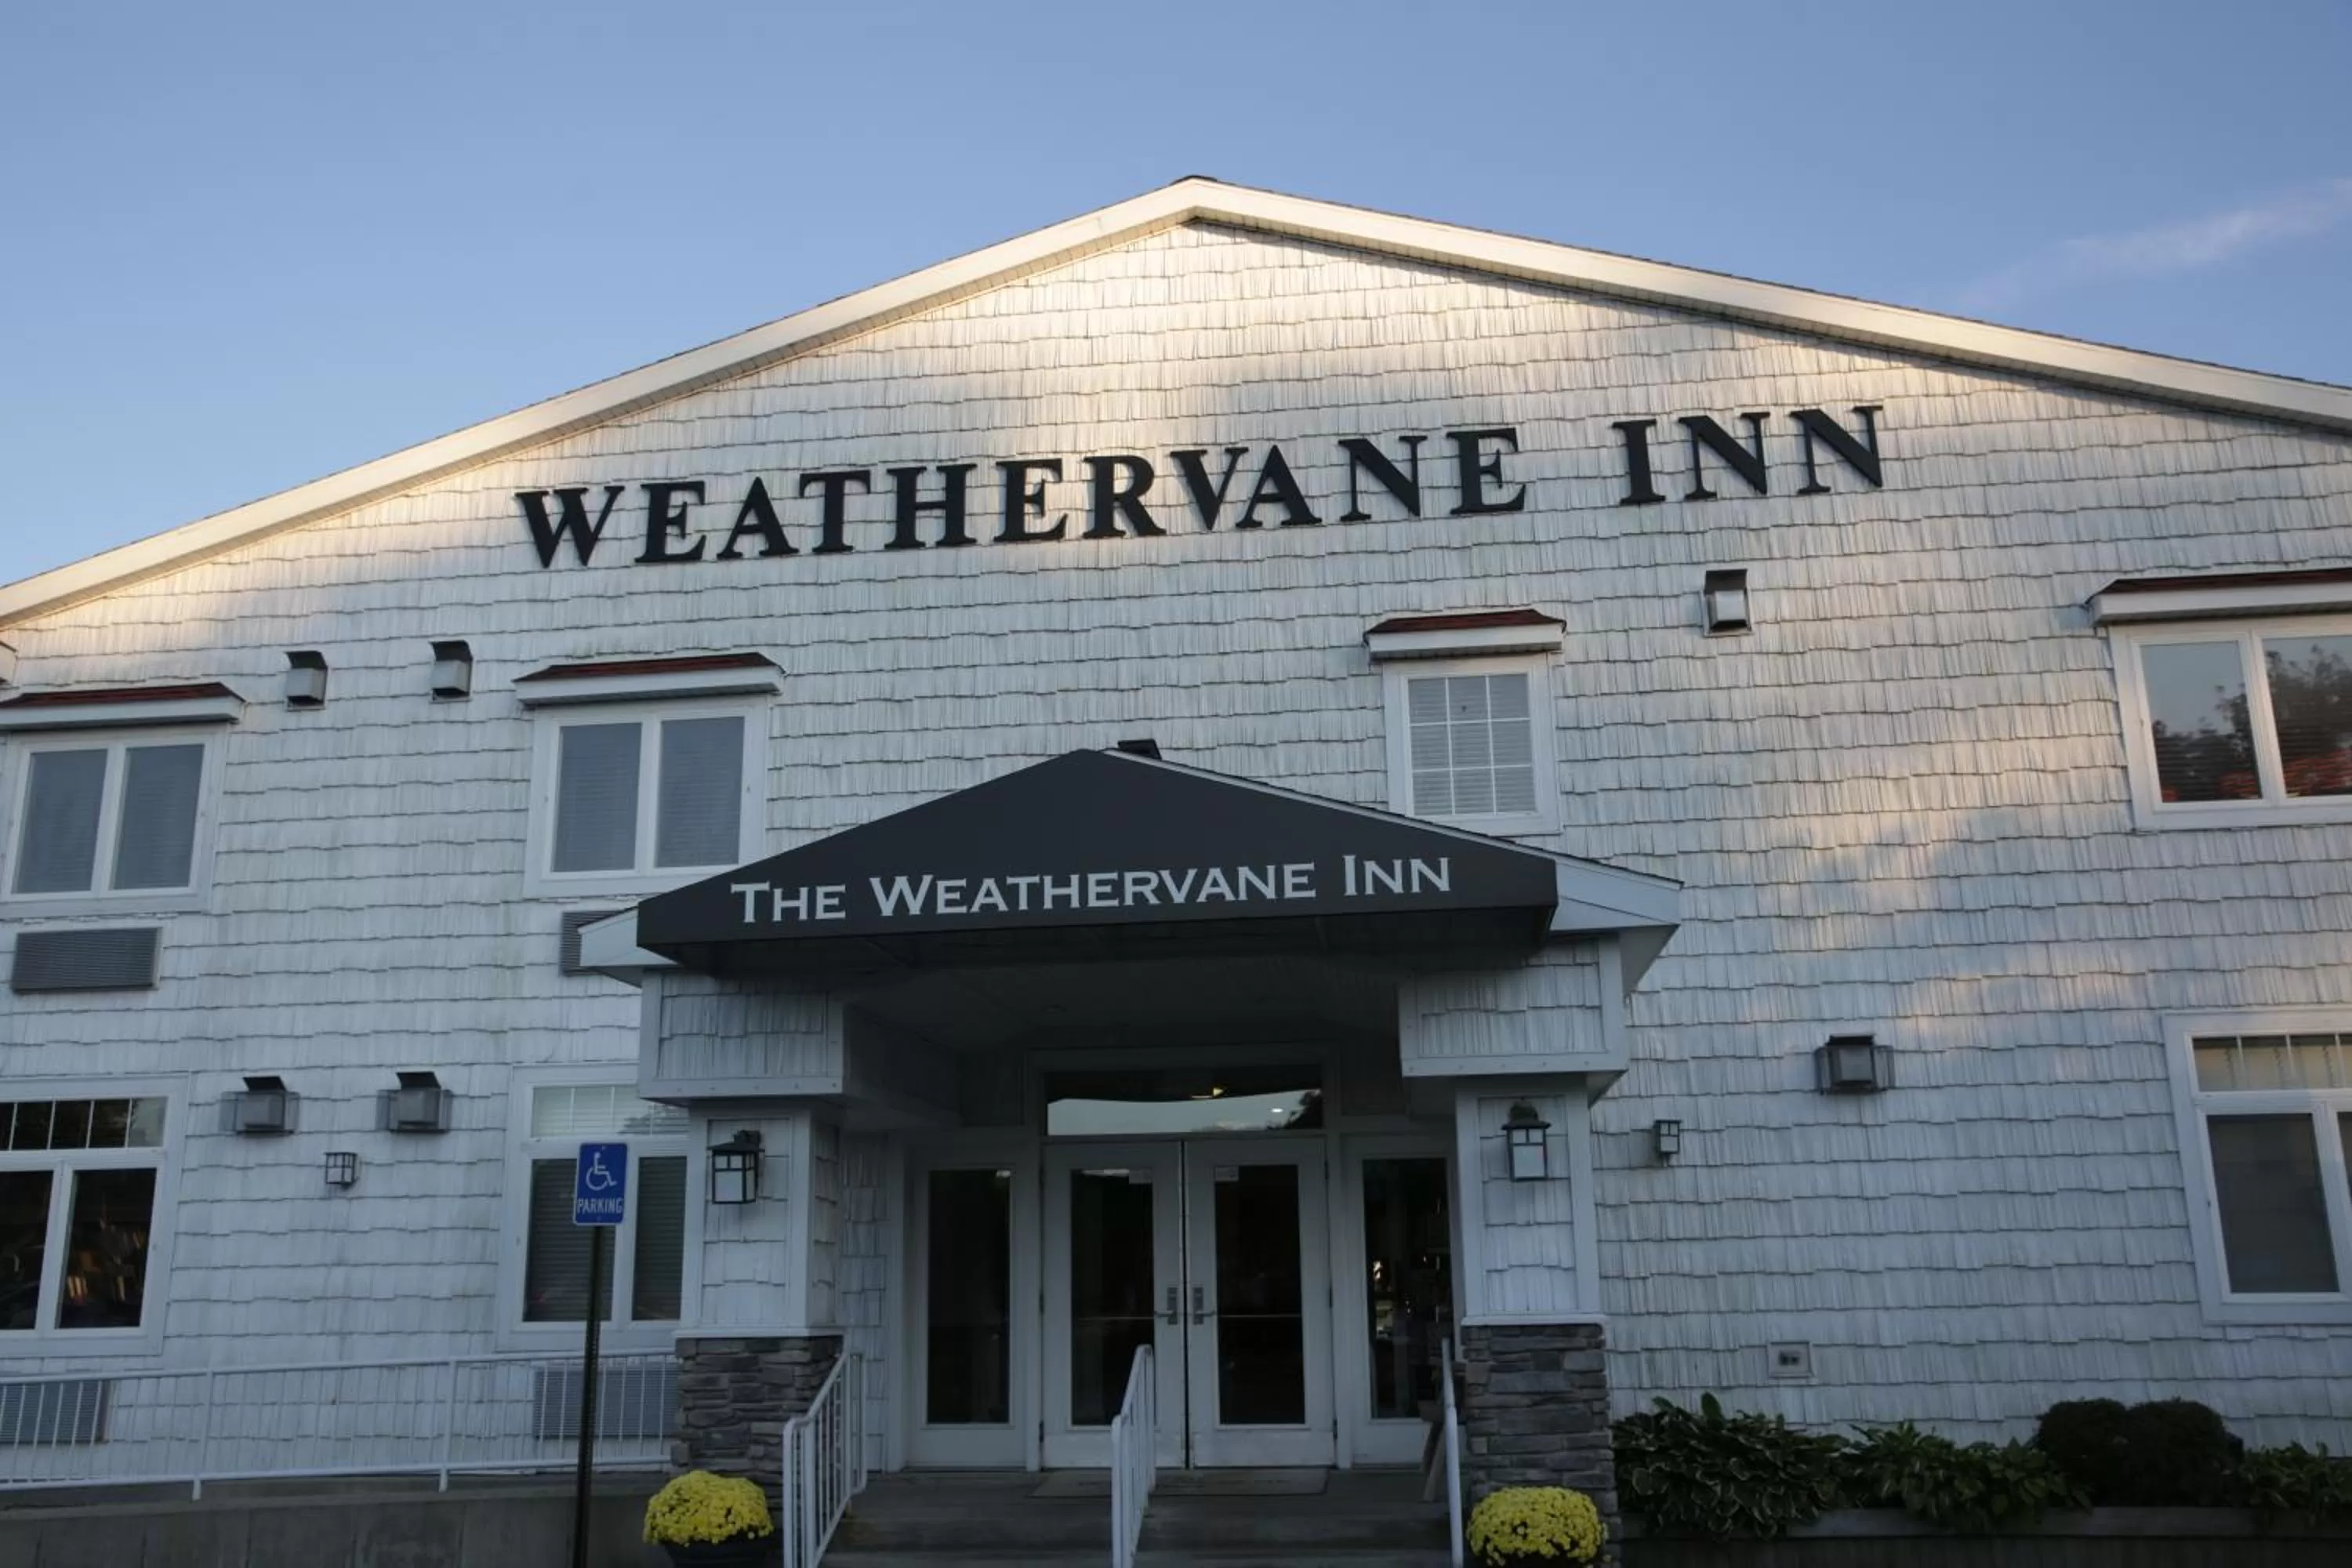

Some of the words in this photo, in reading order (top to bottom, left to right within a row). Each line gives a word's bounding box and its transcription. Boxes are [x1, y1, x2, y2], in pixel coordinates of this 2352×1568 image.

[515, 425, 1526, 569] WEATHERVANE
[1611, 405, 1883, 506] INN
[731, 882, 846, 923] THE
[869, 862, 1316, 916] WEATHERVANE
[1343, 855, 1451, 896] INN
[576, 1197, 623, 1214] PARKING
